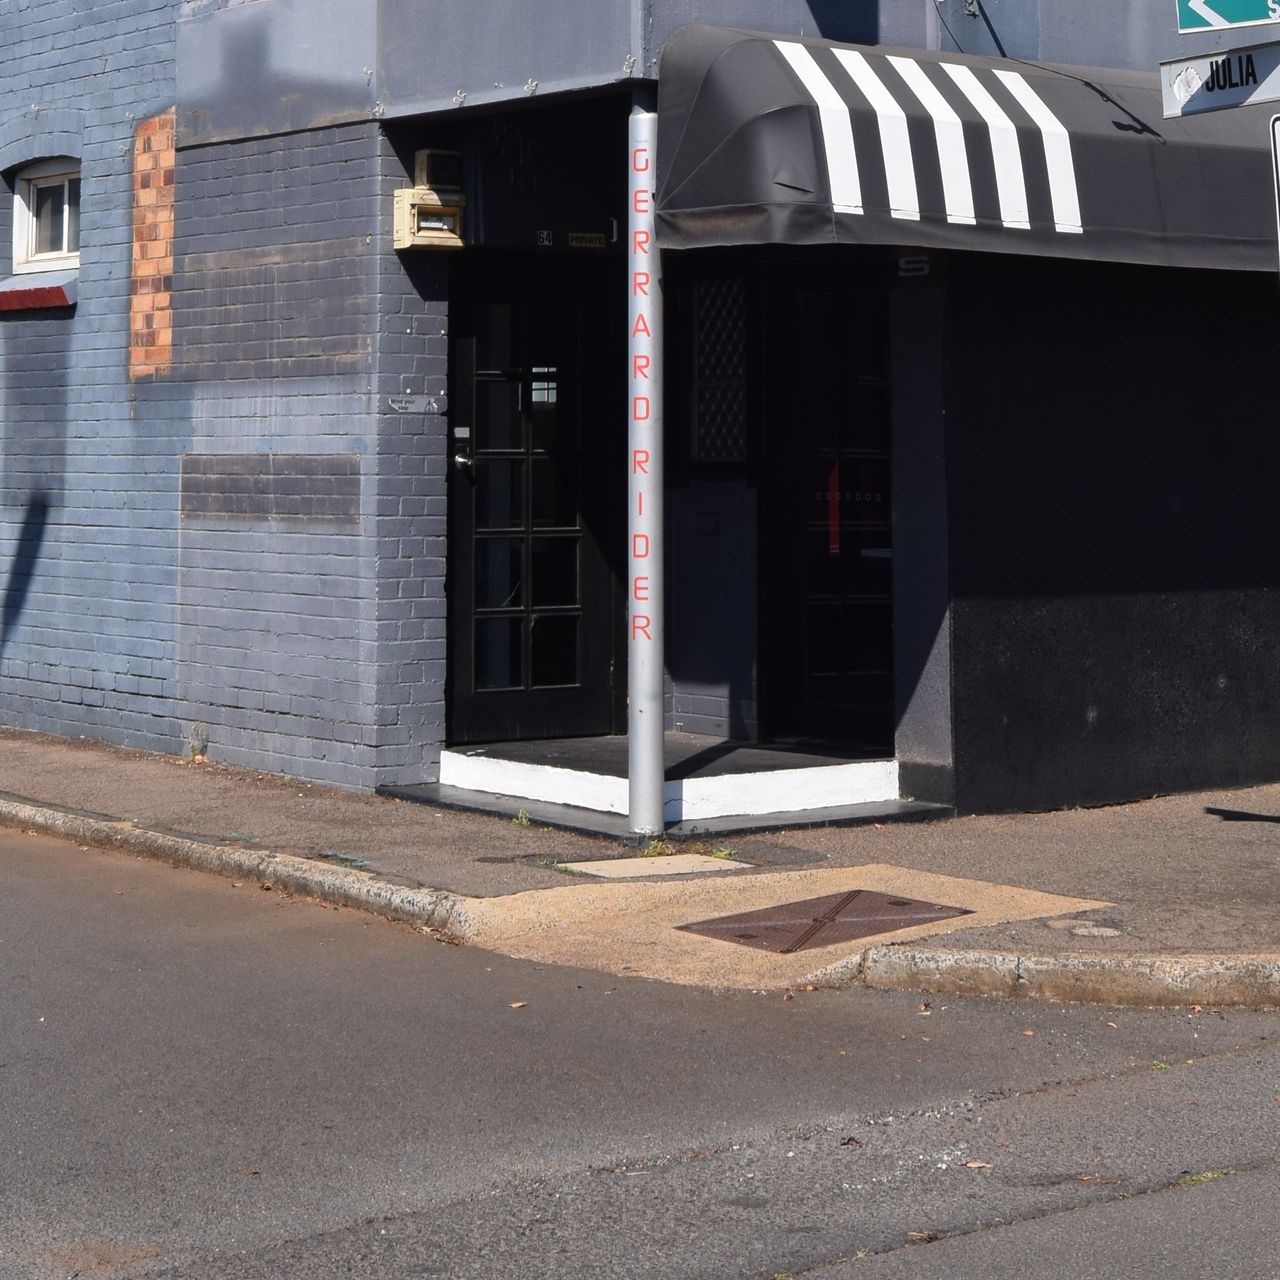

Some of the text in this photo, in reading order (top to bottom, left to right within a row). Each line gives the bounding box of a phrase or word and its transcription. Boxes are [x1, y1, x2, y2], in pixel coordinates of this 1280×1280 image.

[1205, 53, 1258, 93] JULIA
[538, 231, 552, 245] 64
[570, 234, 605, 245] PRIVATE
[632, 148, 652, 640] GERRARD RIDER
